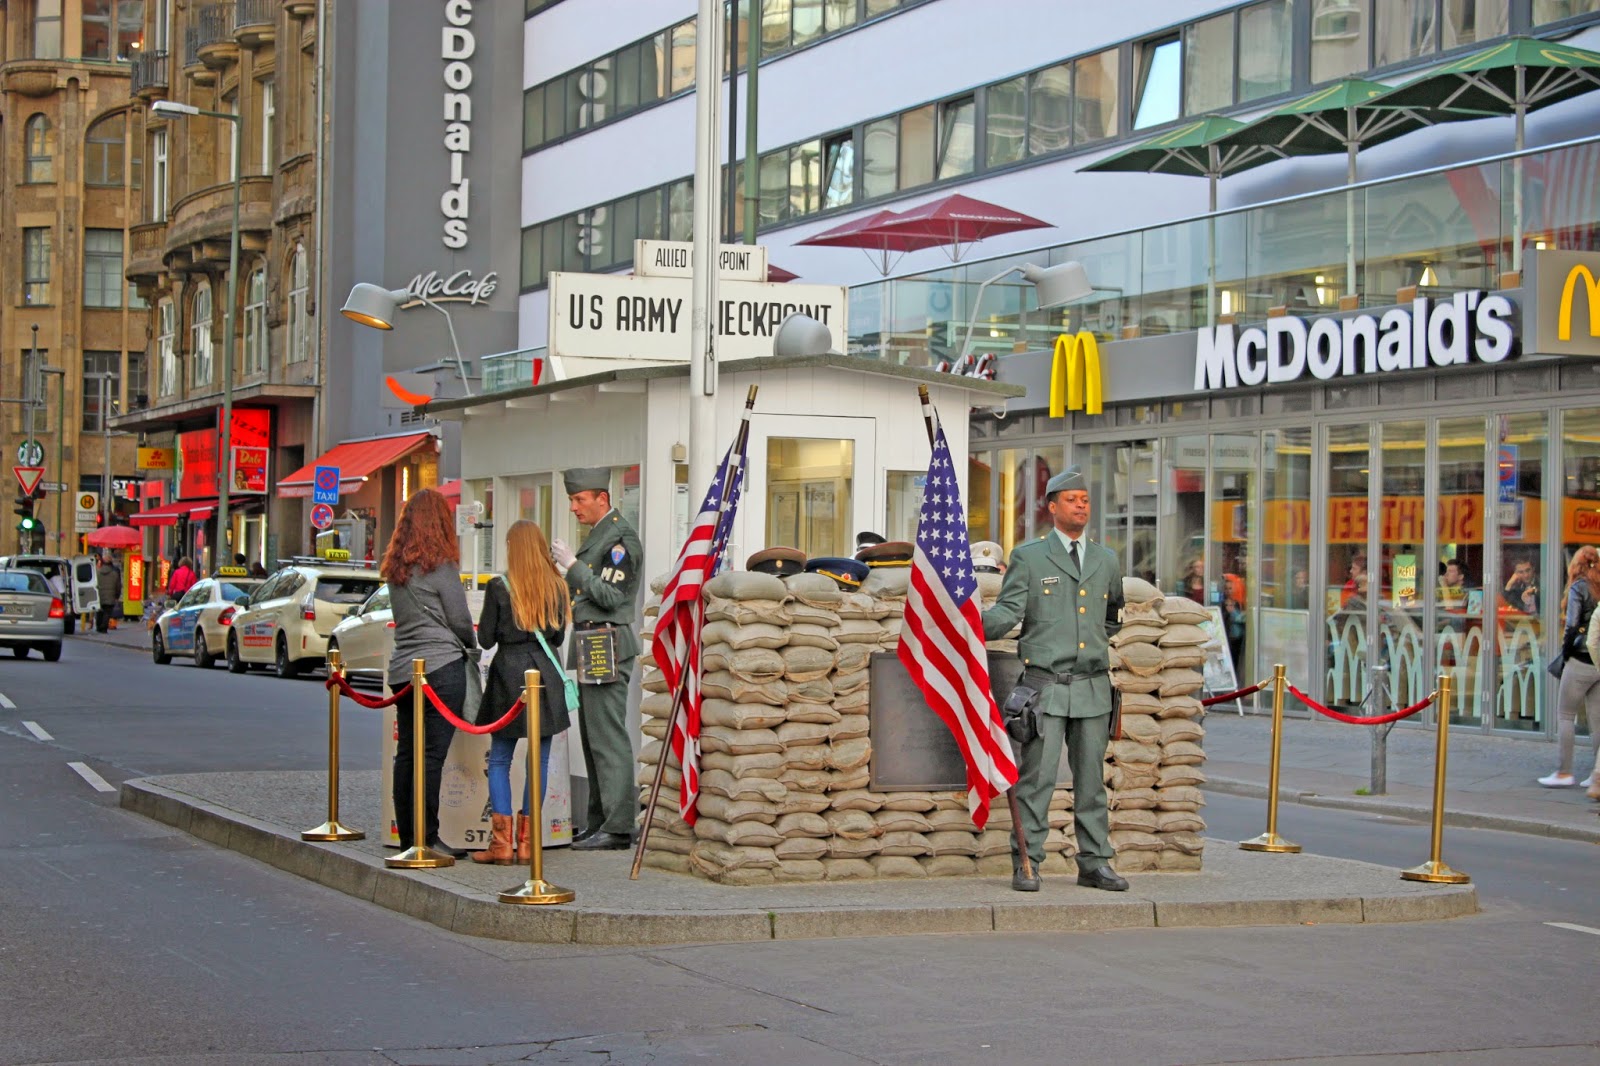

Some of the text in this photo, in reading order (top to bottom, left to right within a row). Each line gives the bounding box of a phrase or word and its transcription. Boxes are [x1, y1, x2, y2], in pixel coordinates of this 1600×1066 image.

[655, 248, 687, 268] ALLIED
[406, 269, 497, 306] McCafé
[570, 294, 603, 330] US
[616, 296, 683, 333] ARMY
[1193, 289, 1513, 391] McDonald's
[316, 491, 336, 501] TAXI
[600, 566, 626, 584] MP
